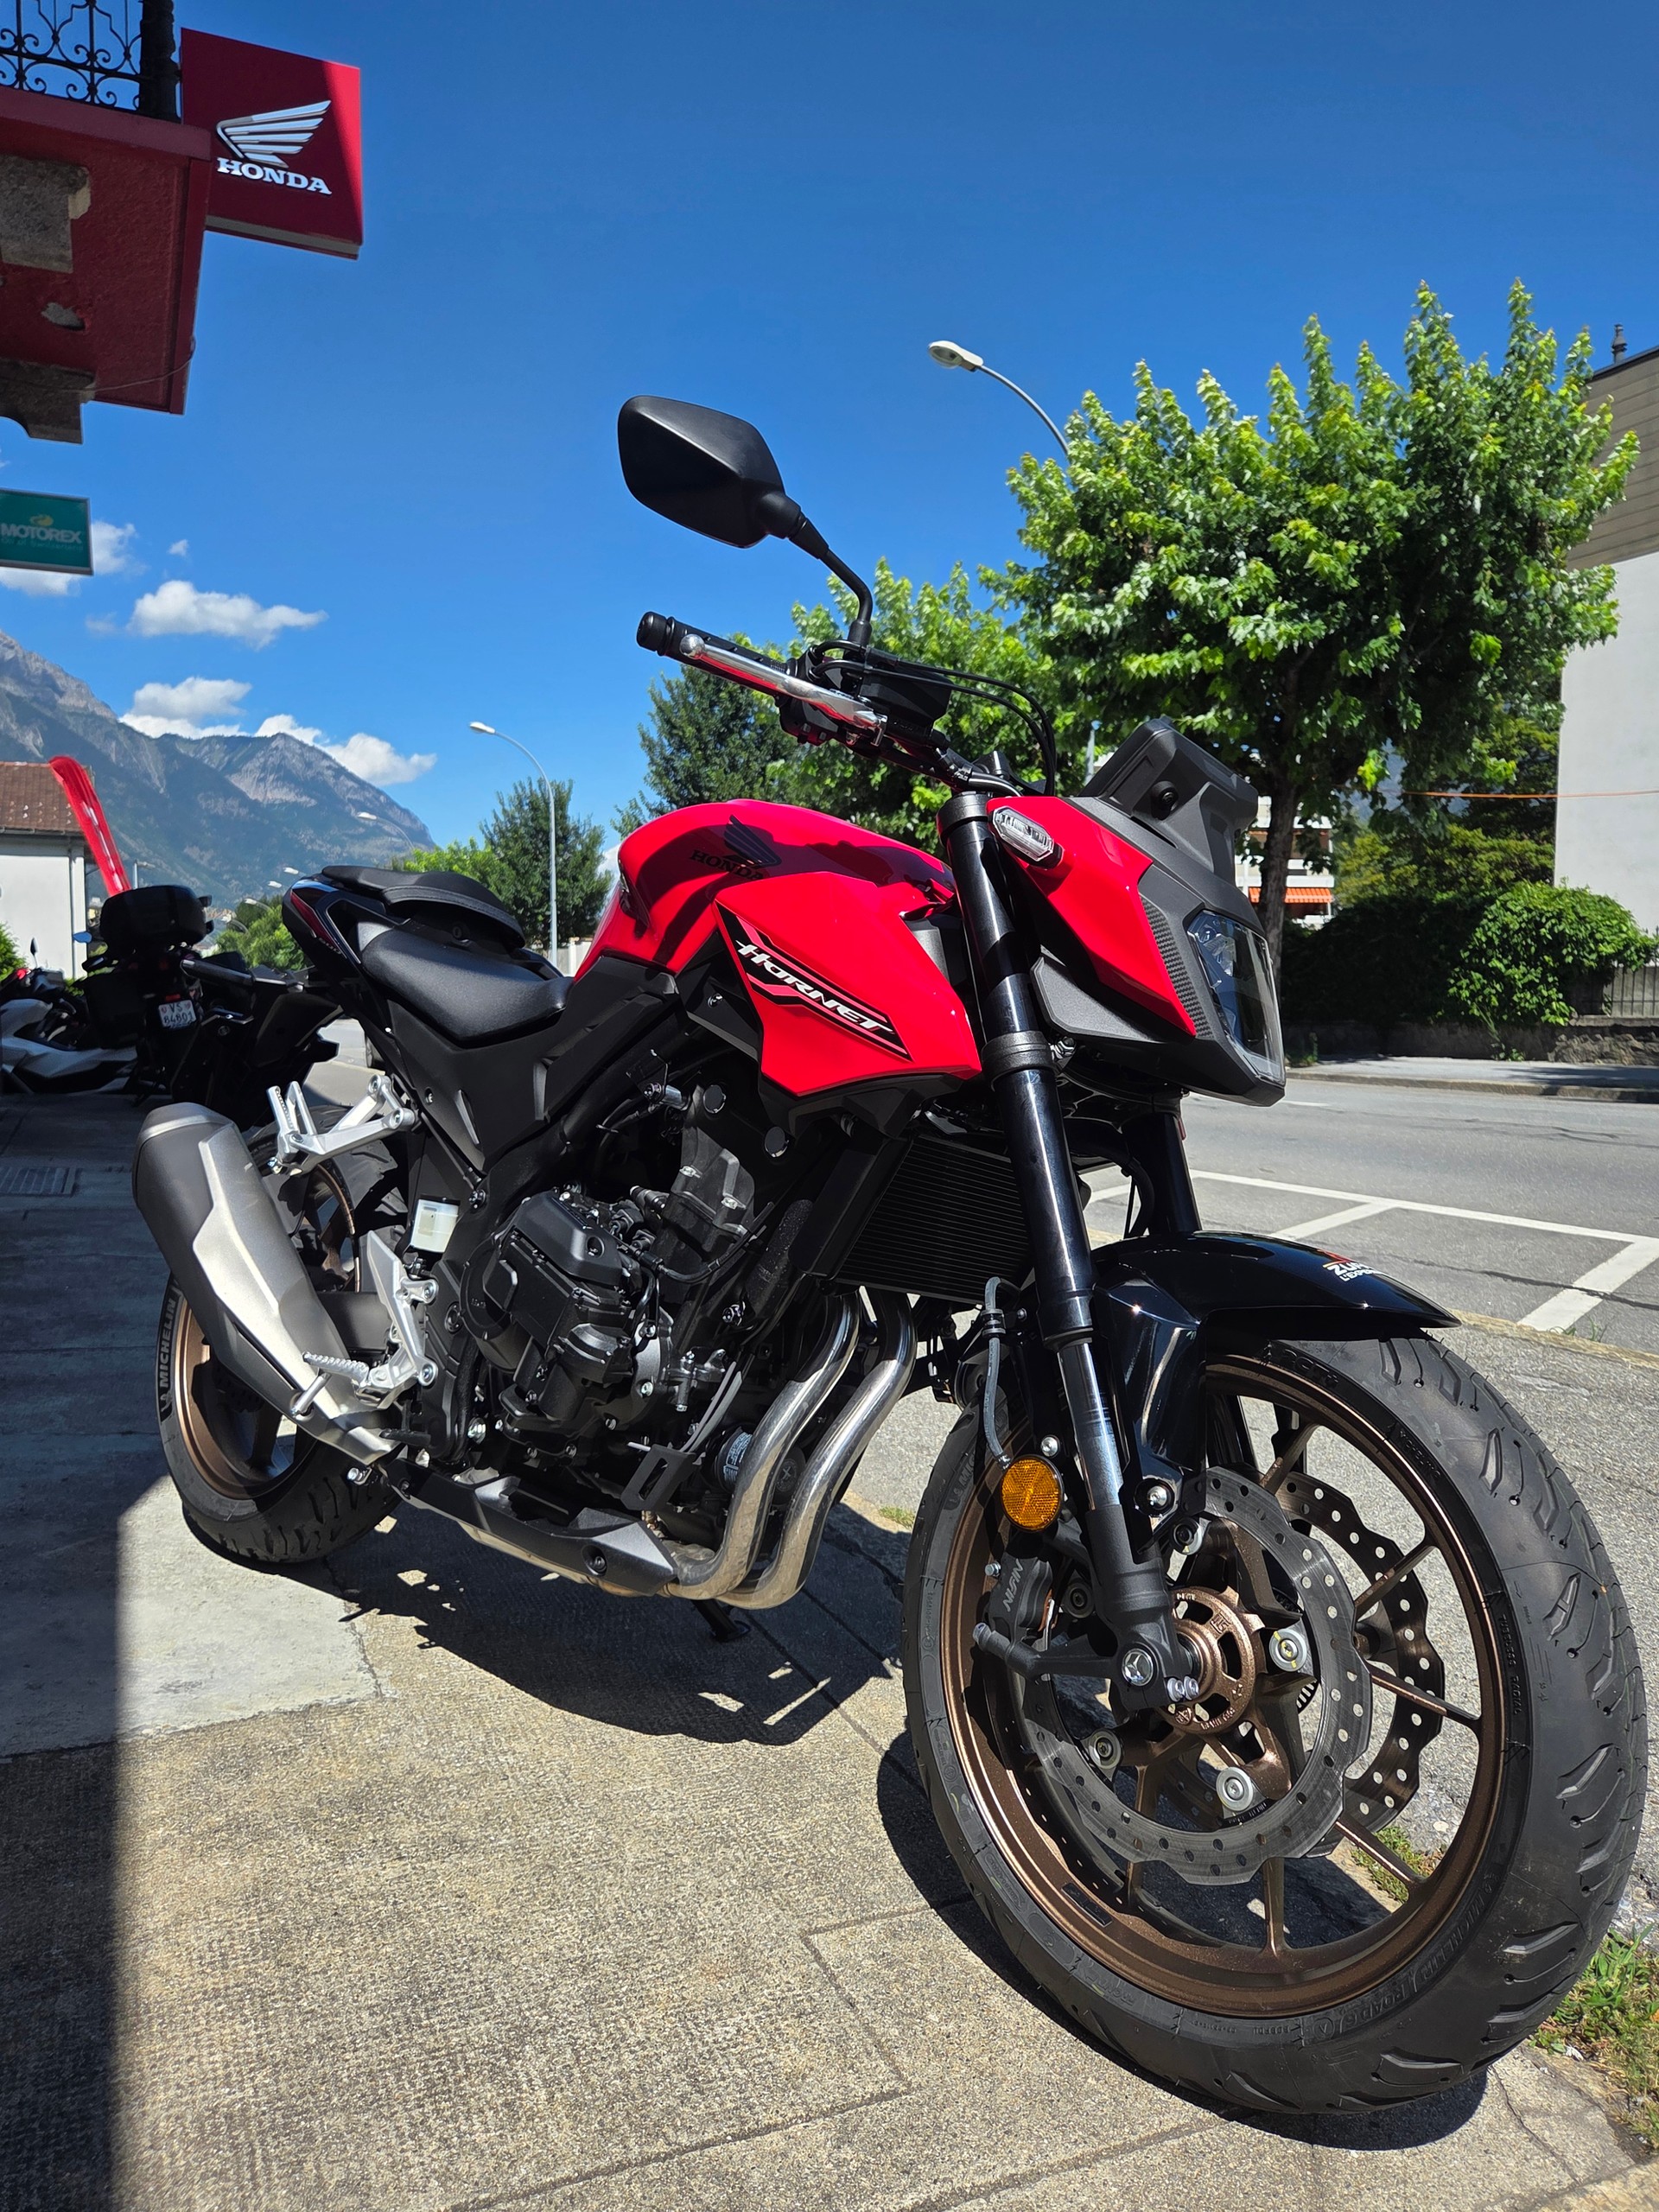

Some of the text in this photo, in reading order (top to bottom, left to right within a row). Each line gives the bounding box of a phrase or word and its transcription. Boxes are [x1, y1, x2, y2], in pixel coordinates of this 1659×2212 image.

[217, 157, 332, 194] HONDA
[1, 523, 82, 543] MOTOREX
[690, 849, 764, 880] HONDA
[735, 940, 893, 1033] HORNET
[168, 1002, 183, 1014] VS
[160, 1298, 176, 1388] MICHELIN
[1003, 1558, 1023, 1612] NISSIN
